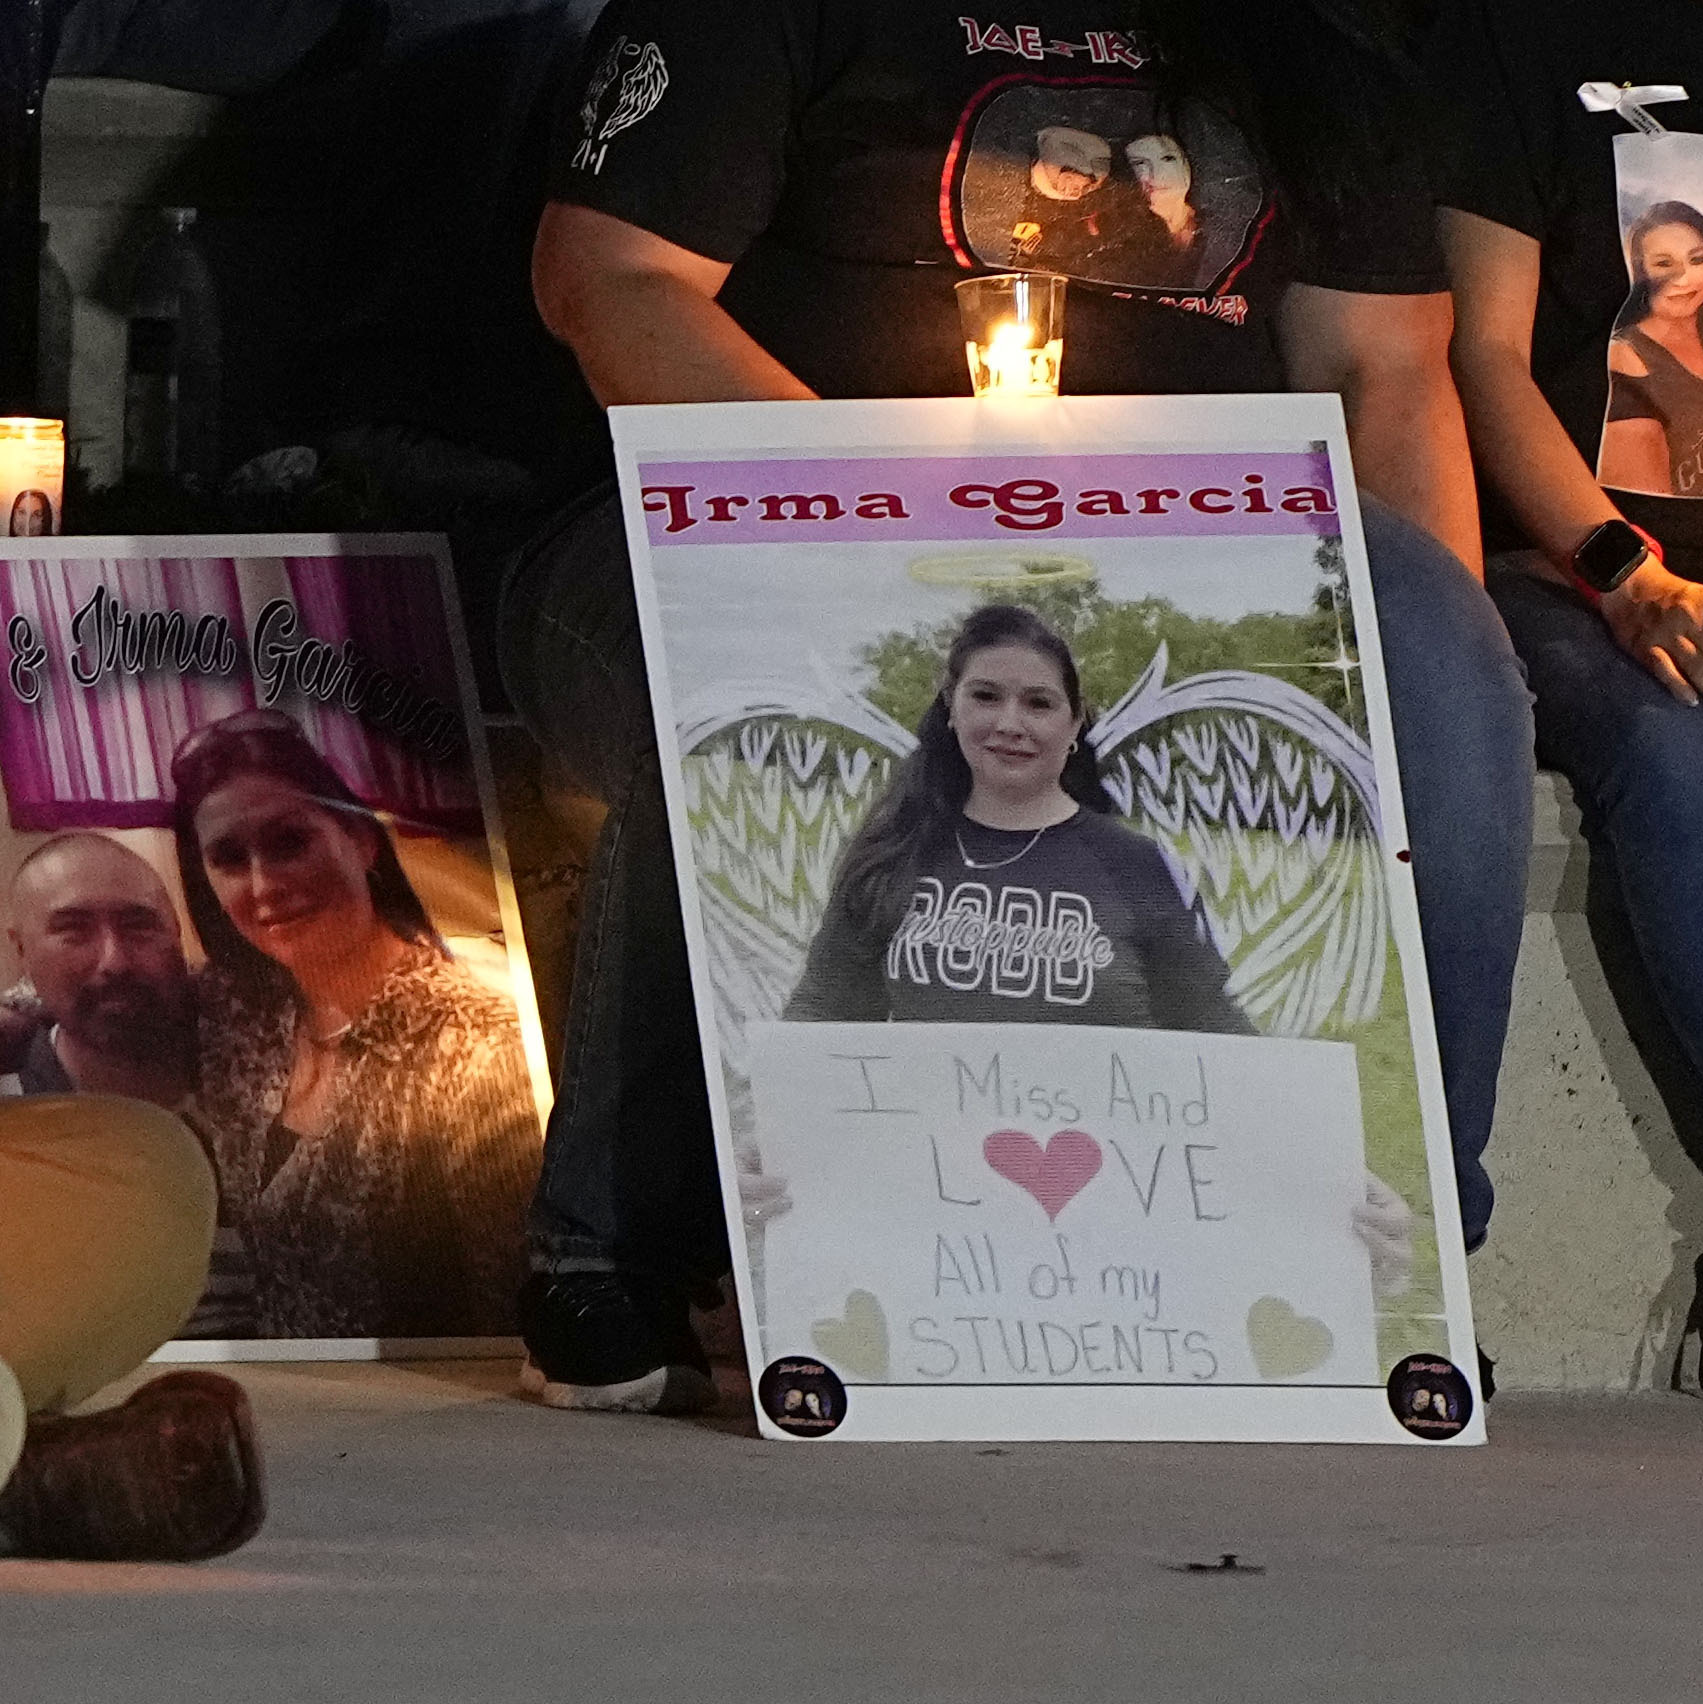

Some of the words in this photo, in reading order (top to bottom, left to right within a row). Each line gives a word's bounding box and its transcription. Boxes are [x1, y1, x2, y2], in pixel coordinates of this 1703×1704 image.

[640, 483, 912, 535] Irma
[948, 473, 1340, 532] Garcia
[70, 584, 237, 687] Irma
[250, 597, 460, 761] Garcia
[828, 1053, 918, 1114] I
[953, 1052, 1082, 1124] Miss
[1109, 1052, 1211, 1127] And
[934, 1232, 1001, 1297] All
[1028, 1232, 1079, 1300] of
[1099, 1263, 1161, 1322] my
[909, 1316, 1218, 1380] STUDENTS
